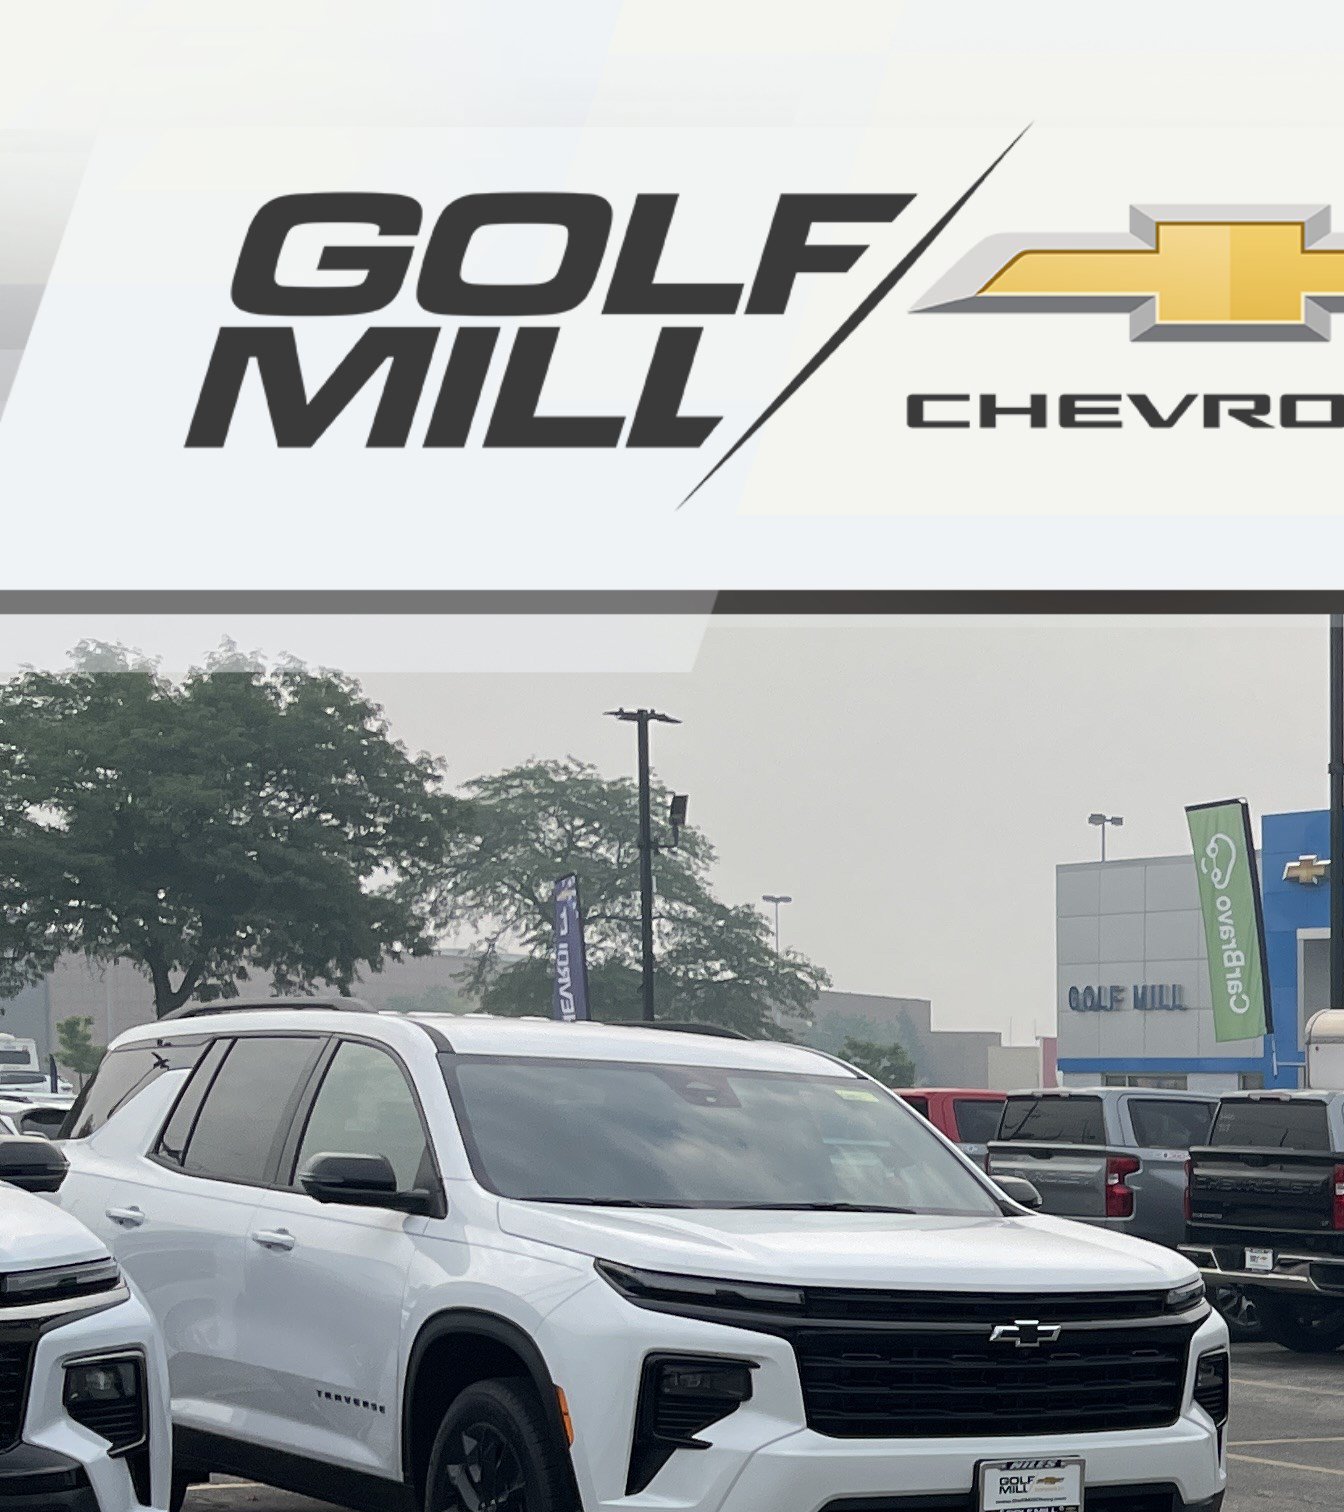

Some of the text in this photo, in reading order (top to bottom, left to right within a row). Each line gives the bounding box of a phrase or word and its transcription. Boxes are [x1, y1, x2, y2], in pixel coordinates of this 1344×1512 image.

[316, 1389, 386, 1414] TRAVERSE
[999, 1475, 1035, 1486] GOLF
[999, 1484, 1028, 1495] MILL
